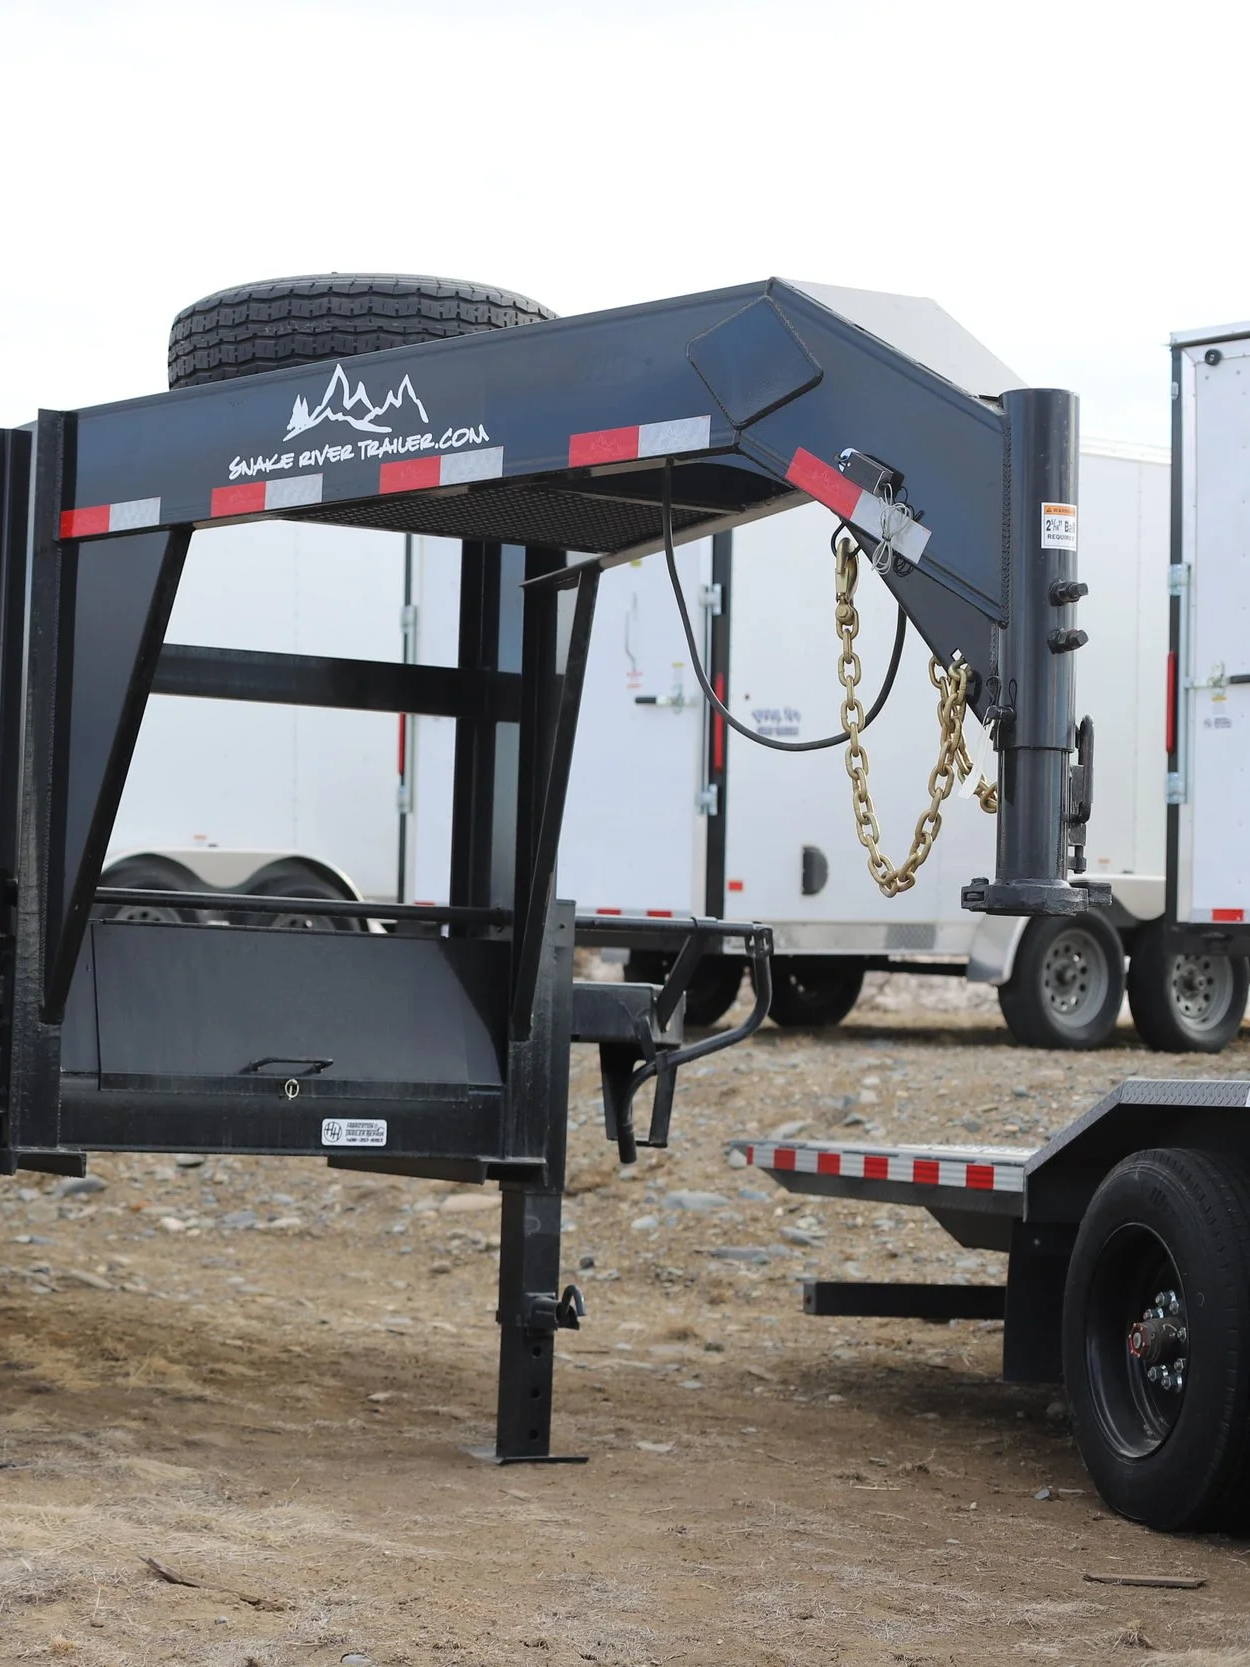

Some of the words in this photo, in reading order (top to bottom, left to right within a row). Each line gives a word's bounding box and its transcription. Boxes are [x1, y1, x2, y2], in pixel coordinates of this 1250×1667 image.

[228, 453, 295, 480] SNAKE
[299, 443, 354, 468] RIVER
[357, 424, 490, 461] TRAILER.COM
